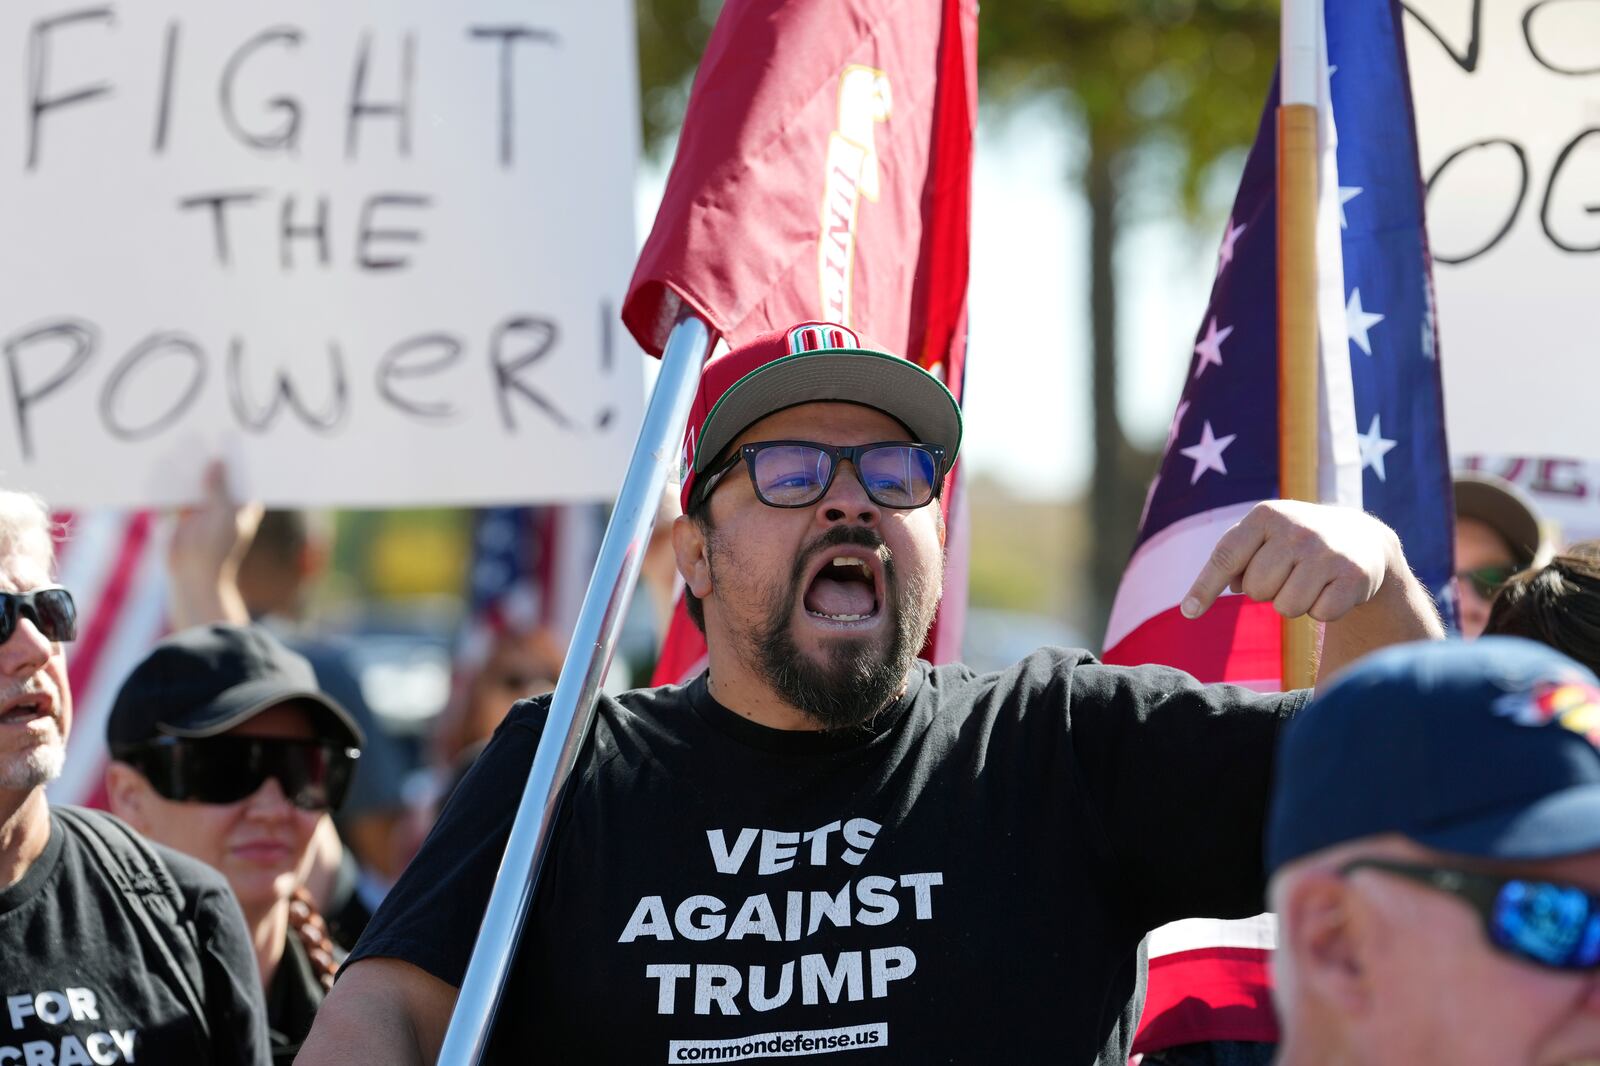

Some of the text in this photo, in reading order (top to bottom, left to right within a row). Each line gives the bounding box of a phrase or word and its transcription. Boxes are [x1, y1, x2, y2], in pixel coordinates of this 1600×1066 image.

[25, 8, 563, 170] FIGHT
[176, 188, 434, 271] THE
[706, 817, 883, 875] VETS
[617, 872, 944, 943] AGAINST
[6, 987, 100, 1030] FOR
[646, 946, 917, 1016] TRUMP
[675, 1028, 880, 1062] commondefense.us
